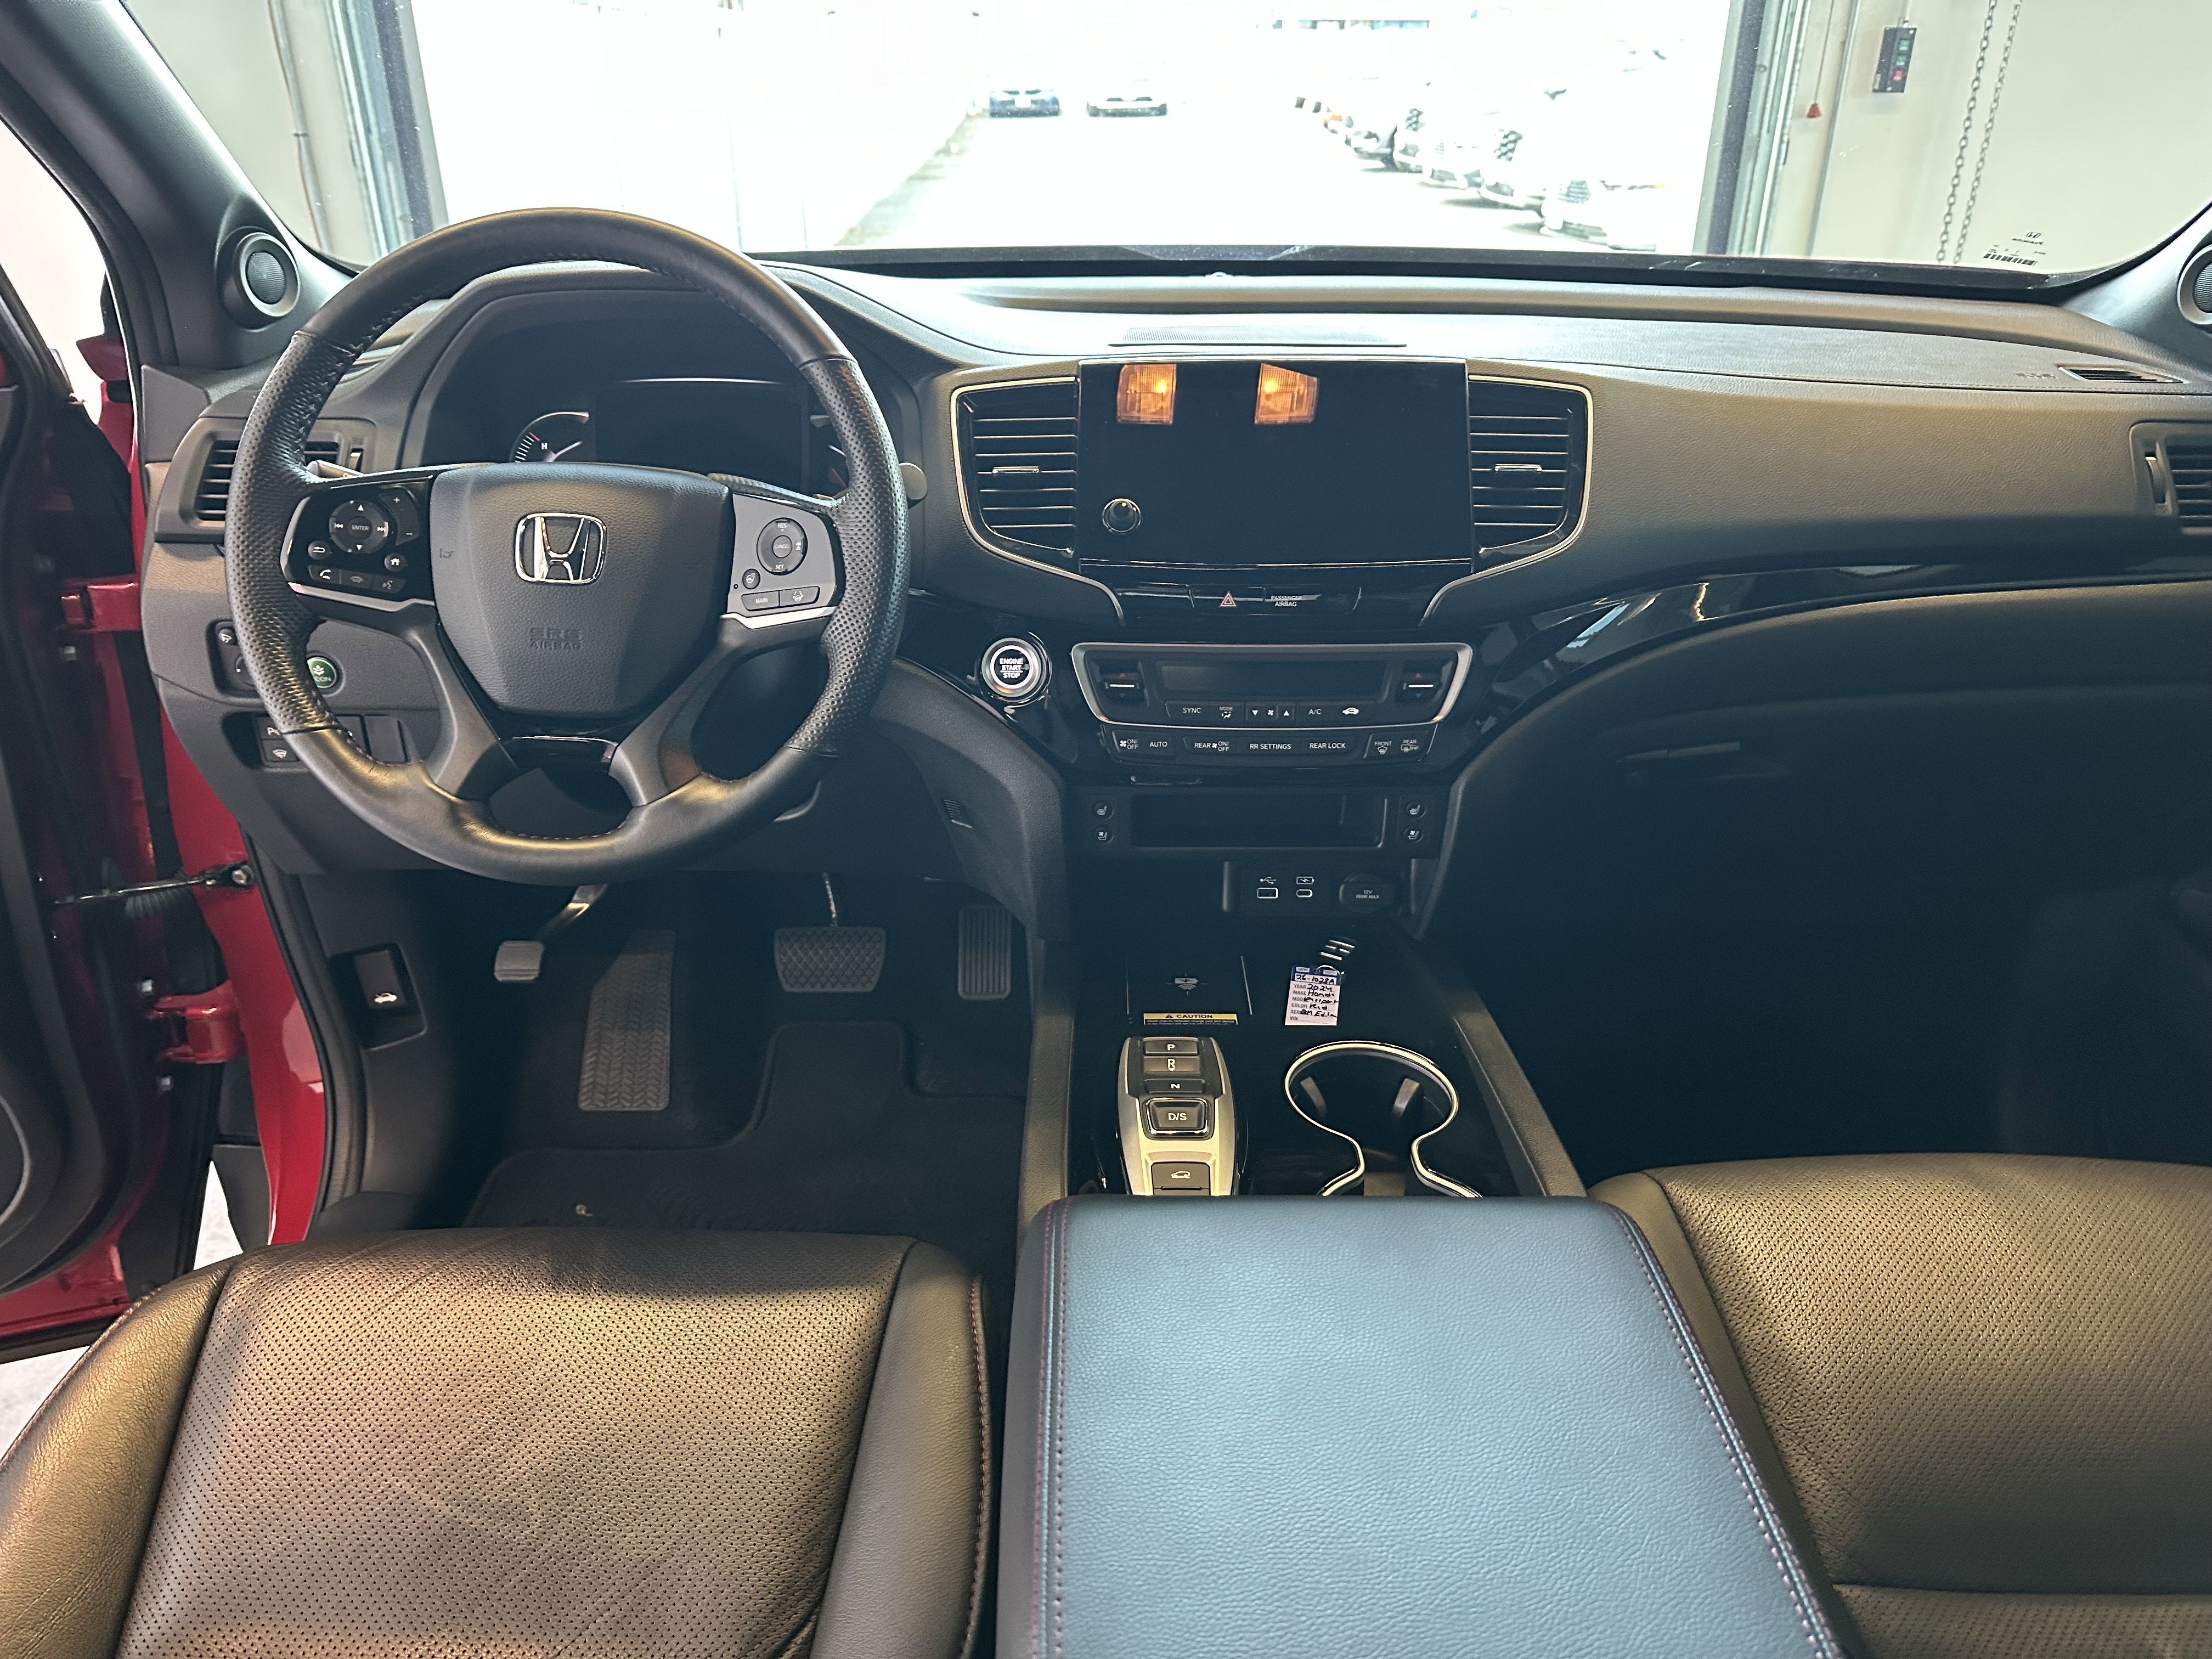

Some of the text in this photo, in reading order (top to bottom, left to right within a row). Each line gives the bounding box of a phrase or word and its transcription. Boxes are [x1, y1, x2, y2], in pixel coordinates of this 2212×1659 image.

[1307, 984, 1332, 992] 2024
[1167, 1058, 1176, 1068] R
[1167, 1113, 1187, 1121] D/S
